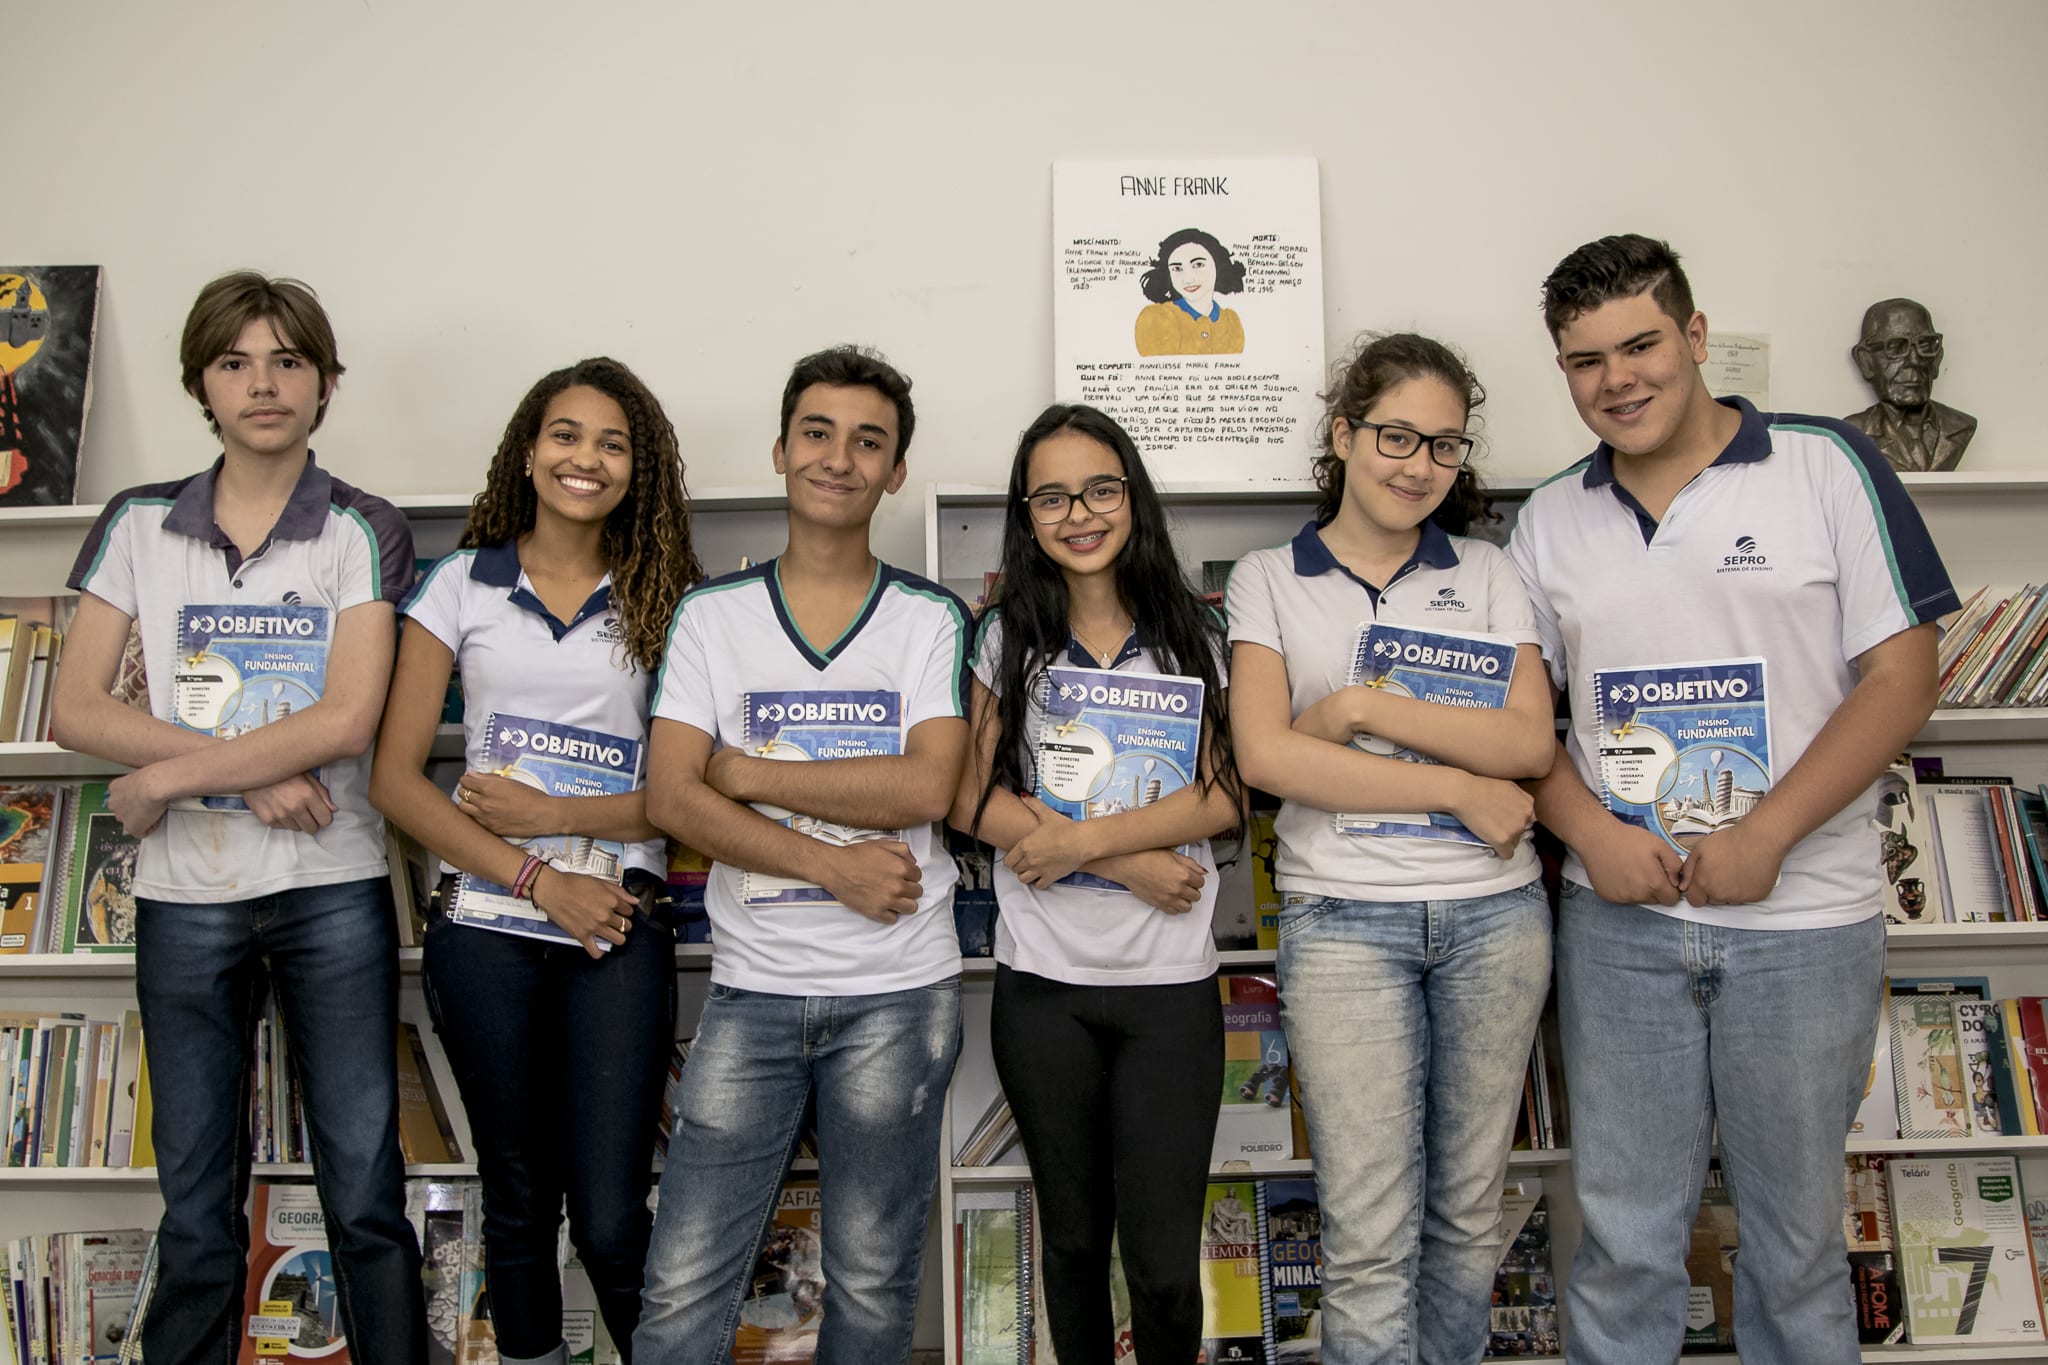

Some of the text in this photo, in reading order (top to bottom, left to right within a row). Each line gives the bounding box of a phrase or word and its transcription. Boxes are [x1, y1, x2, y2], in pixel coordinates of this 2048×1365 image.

[1121, 176, 1229, 196] ANNE FRANK
[1222, 426, 1248, 434] PELOS
[1154, 434, 1180, 442] CAMPO
[1724, 555, 1766, 566] SEPRO
[1430, 600, 1465, 608] SEPRO
[218, 616, 314, 636] OBJETIVO
[244, 660, 315, 672] FUNDAMENTAL
[1404, 644, 1500, 676] OBJETIVO
[1446, 688, 1474, 698] ENSINO
[1642, 678, 1748, 702] OBJETIVO
[1090, 685, 1188, 713] OBJETIVO
[787, 703, 887, 723] OBJETIVO
[1698, 719, 1730, 727] ENSINO
[1138, 728, 1166, 736] ENSINO
[1677, 726, 1754, 740] FUNDAMENTAL
[530, 732, 624, 767] OBJETIVO
[1117, 734, 1186, 752] FUNDAMENTAL
[575, 777, 603, 788] ENSINO
[1224, 1011, 1272, 1026] eografia
[1962, 1020, 1985, 1032] DO
[1266, 1039, 1280, 1064] 6
[1240, 1144, 1282, 1152] POLIEDRO
[1901, 1168, 1930, 1178] Teláris
[1946, 1163, 1964, 1226] Geografia
[279, 1212, 326, 1225] GEOGRA
[810, 1211, 820, 1230] 9
[1236, 1262, 1259, 1276] HIS
[1869, 1267, 1890, 1329] A FOME
[1938, 1246, 1994, 1336] 7
